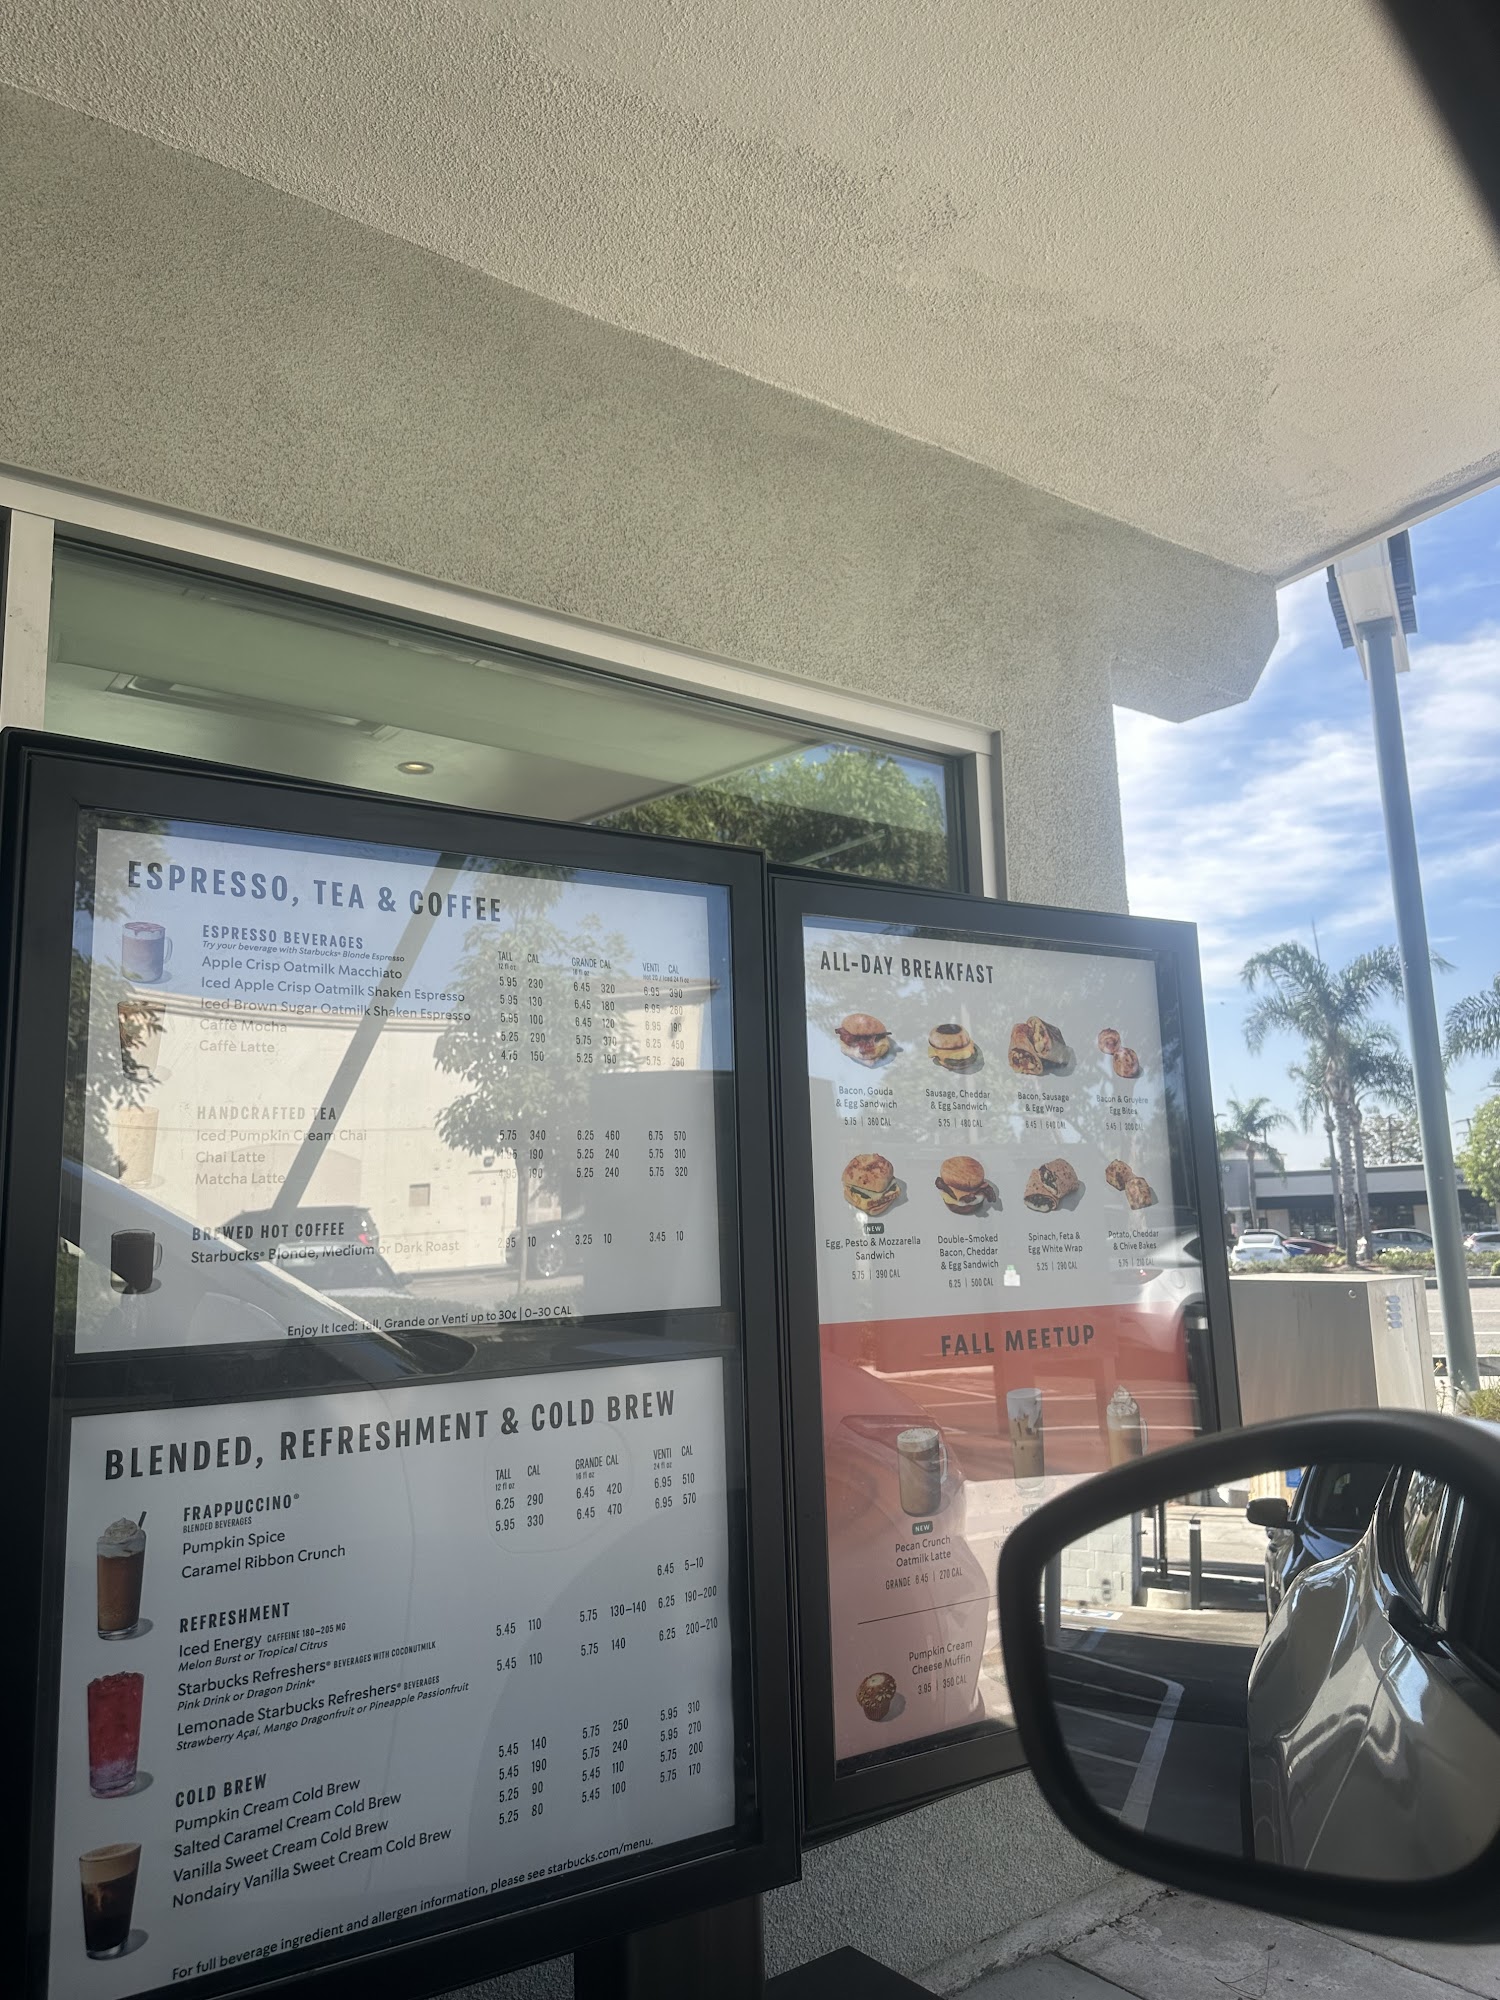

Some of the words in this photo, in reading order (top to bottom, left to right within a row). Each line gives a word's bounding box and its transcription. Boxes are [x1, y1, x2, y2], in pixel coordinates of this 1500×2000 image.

[128, 861, 299, 907] ESPRESSO,
[314, 879, 364, 909] TEA
[378, 886, 396, 912] &
[410, 890, 500, 922] COFFEE
[203, 925, 277, 943] ESPRESSO
[284, 931, 363, 949] BEVERAGES
[203, 941, 217, 950] Try
[220, 944, 236, 952] your
[238, 943, 276, 954] beverage
[279, 946, 297, 954] with
[343, 950, 367, 959] Blonde
[369, 952, 404, 963] Espresso
[498, 951, 512, 962] TALL
[528, 953, 539, 963] CAL
[202, 956, 242, 972] Apple
[246, 958, 280, 974] Crisp
[284, 960, 335, 975] Oatmilk
[338, 965, 402, 979] Macchiato
[572, 957, 596, 968] GRANDE
[600, 959, 611, 969] CAL
[643, 963, 660, 972] VENTI
[668, 964, 679, 974] CAL
[821, 951, 892, 975] ALL-DAY
[901, 958, 994, 984] BREAKFAST
[202, 977, 230, 990] Iced
[234, 978, 274, 993] Apple
[277, 980, 311, 994] Crisp
[315, 982, 364, 997] Oatmilk
[368, 986, 411, 999] Shaken
[415, 989, 464, 1002] Espresso
[499, 977, 517, 987] 5.95
[528, 979, 543, 989] 230
[574, 982, 590, 992] 6.45
[601, 984, 615, 994] 320
[644, 987, 659, 997] 6.95
[669, 988, 682, 998] 390
[839, 1086, 865, 1095] Bacon,
[867, 1087, 893, 1096] Gouda
[926, 1089, 958, 1099] Sausage,
[960, 1090, 990, 1099] Cheddar
[197, 1106, 305, 1120] HANDCRAFTED
[312, 1107, 336, 1120] TEA
[844, 1099, 858, 1109] Egg
[860, 1099, 897, 1108] Sandwich
[939, 1102, 951, 1111] Egg
[953, 1102, 988, 1110] Sandwich
[500, 1130, 516, 1140] 5.75
[530, 1130, 546, 1140] 340
[577, 1130, 594, 1141] 6.25
[605, 1130, 620, 1140] 460
[649, 1131, 663, 1141] 6.75
[674, 1131, 686, 1141] 570
[196, 1151, 226, 1163] Chai
[231, 1151, 265, 1163] Latte
[192, 1225, 253, 1240] BREWED
[261, 1224, 288, 1238] HOT
[295, 1222, 345, 1236] COFFEE
[938, 1235, 998, 1243] Double-Smoked
[268, 1247, 319, 1260] Blonde,
[322, 1244, 375, 1257] Medium
[378, 1246, 391, 1254] or
[395, 1242, 422, 1254] Dark
[425, 1240, 459, 1252] Roast
[846, 1238, 868, 1247] Pesto
[871, 1238, 876, 1246] &
[879, 1236, 920, 1246] Mozzarella
[856, 1251, 895, 1260] Sandwich
[940, 1248, 965, 1257] Bacon,
[967, 1247, 998, 1255] Cheddar
[889, 1269, 900, 1278] CAL
[949, 1261, 962, 1271] Egg
[963, 1261, 998, 1269] Sandwich
[941, 1332, 994, 1356] FALL
[1005, 1324, 1095, 1351] MEETUP
[105, 1436, 264, 1480] BLENDED,
[280, 1410, 488, 1461] REFRESHMENT
[501, 1408, 519, 1435] &
[532, 1398, 594, 1431] COLD
[608, 1390, 674, 1422] BREW
[654, 1476, 672, 1488] 6.95
[683, 1473, 695, 1484] 510
[577, 1486, 594, 1499] 6.45
[607, 1482, 622, 1494] 420
[496, 1497, 515, 1511] 6.25
[527, 1493, 544, 1506] 290
[183, 1522, 213, 1533] BLENDED
[215, 1517, 252, 1530] BEVERAGES
[182, 1536, 244, 1555] Pumpkin
[248, 1531, 285, 1548] Spice
[895, 1541, 920, 1553] Pecan
[922, 1535, 950, 1548] Crunch
[182, 1559, 241, 1578] Caramel
[245, 1553, 294, 1569] Ribbon
[298, 1545, 346, 1562] Crunch
[896, 1555, 929, 1567] Oatmilk
[931, 1550, 951, 1561] Latte
[885, 1576, 911, 1590] GRANDE
[952, 1568, 962, 1577] CAL
[179, 1602, 290, 1632] REFRESHMENT
[179, 1640, 210, 1657] Iced
[214, 1635, 262, 1652] Energy
[267, 1630, 300, 1642] CAFFEINE
[338, 1623, 346, 1631] MG
[909, 1646, 945, 1662] Pumpkin
[947, 1640, 973, 1652] Cream
[178, 1674, 249, 1696] Starbucks
[333, 1654, 371, 1669] BEVERAGES
[373, 1650, 389, 1661] WITH
[391, 1641, 436, 1657] COCONUTMILK
[912, 1660, 942, 1675] Cheese
[944, 1654, 971, 1668] Muffin
[177, 1699, 200, 1712] Pink
[202, 1694, 230, 1707] Drink
[233, 1692, 243, 1700] or
[247, 1684, 283, 1700] Dragon
[660, 1769, 677, 1783] 5.75
[689, 1763, 701, 1776] 170
[175, 1785, 216, 1808] COLD
[224, 1774, 267, 1797] BREW
[582, 1788, 600, 1803] 5.45
[612, 1781, 626, 1795] 100
[175, 1808, 239, 1832] Pumpkin
[244, 1797, 289, 1817] Cream
[293, 1786, 323, 1804] Cold
[327, 1778, 360, 1796] Brew
[499, 1810, 519, 1825] 5.25
[531, 1803, 543, 1816] 80
[173, 1880, 240, 1908] Nondairy
[244, 1868, 289, 1889] Vanilla
[293, 1856, 335, 1876] Sweet
[338, 1845, 383, 1865] Cream
[386, 1835, 416, 1853] Cold
[420, 1828, 451, 1845] Brew
